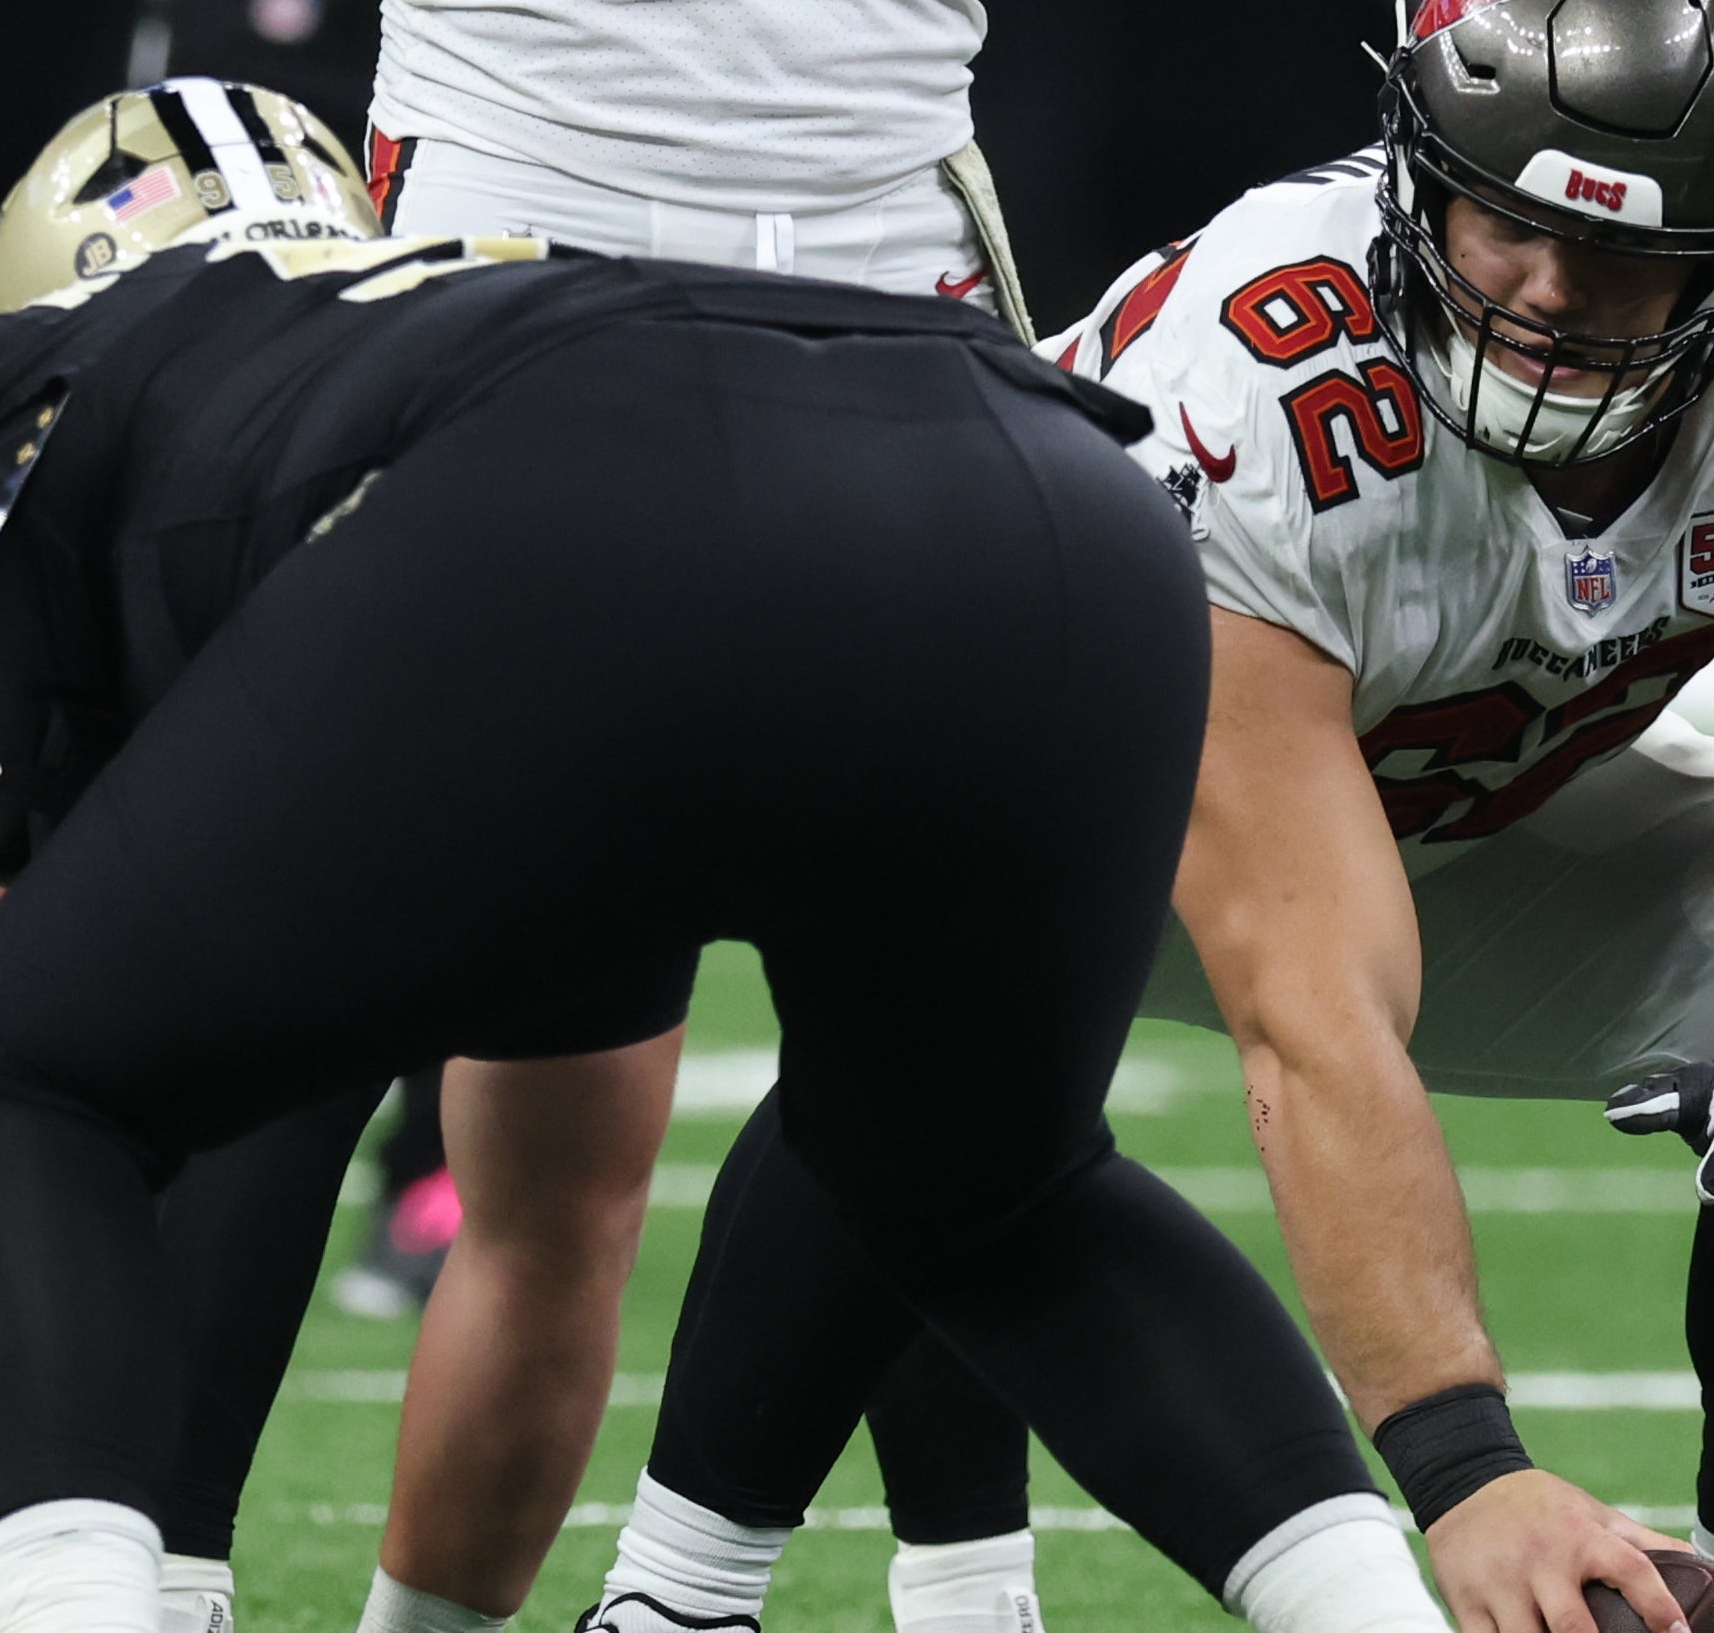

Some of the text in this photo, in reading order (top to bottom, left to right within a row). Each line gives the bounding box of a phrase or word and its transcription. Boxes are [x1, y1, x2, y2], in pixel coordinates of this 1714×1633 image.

[1565, 169, 1627, 213] BUCS
[1219, 254, 1425, 515] 62
[1575, 576, 1611, 601] NFL
